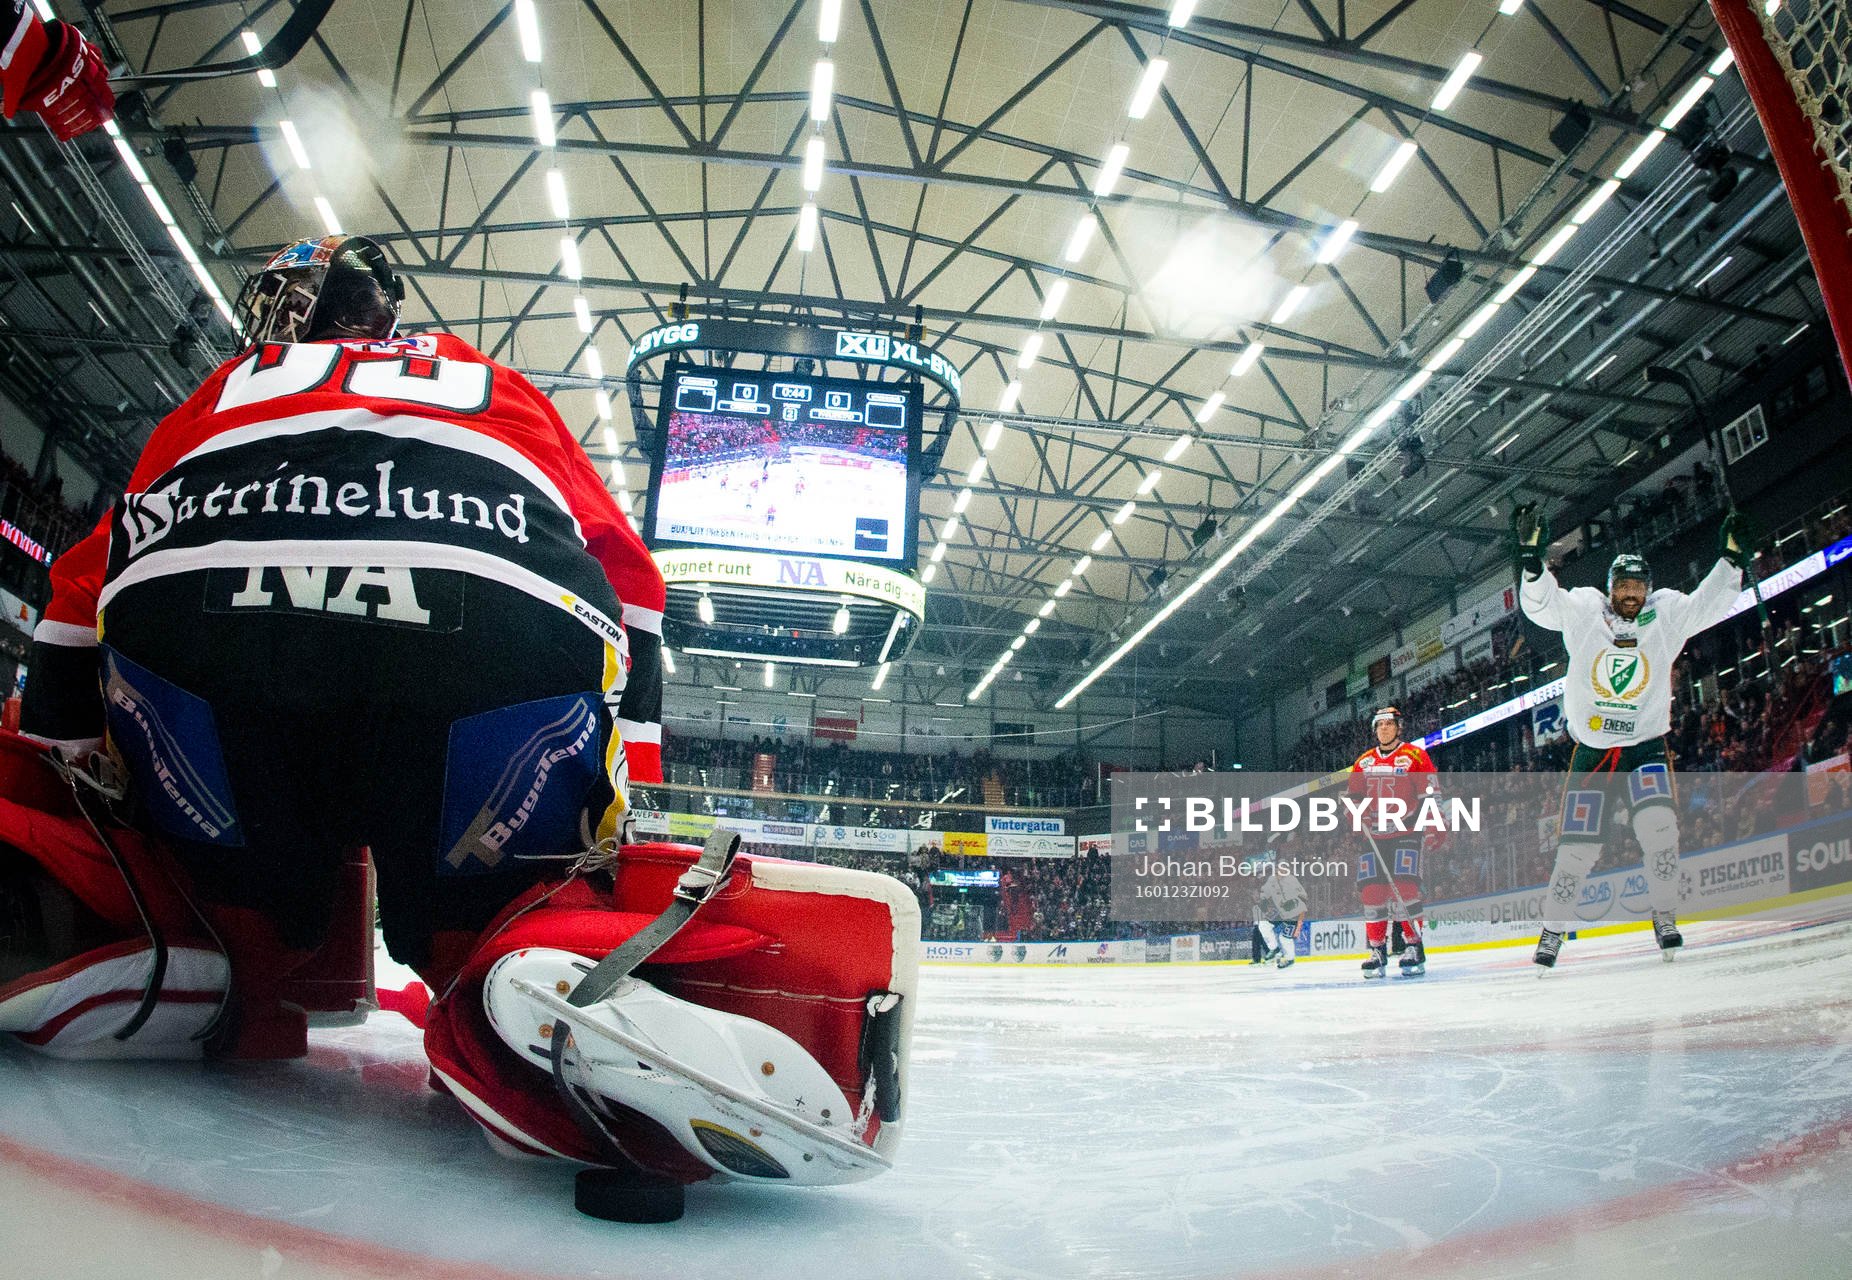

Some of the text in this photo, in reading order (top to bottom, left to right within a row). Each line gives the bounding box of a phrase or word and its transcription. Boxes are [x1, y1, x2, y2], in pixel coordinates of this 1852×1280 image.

[628, 323, 699, 368] L-BYGG
[892, 341, 960, 399] XL-BYG
[742, 387, 751, 398] 0
[832, 395, 841, 407] 0
[663, 560, 752, 576] dygnet runt
[776, 559, 827, 587] NA
[845, 571, 903, 598] Nära dig
[574, 603, 622, 643] EASTON
[1603, 718, 1635, 733] ENERGI
[479, 712, 597, 851] ByggTema
[854, 828, 878, 840] Let's
[991, 818, 1060, 833] Vintergatan
[1700, 851, 1785, 887] PISCATOR
[1701, 872, 1785, 897] ventilation ab
[927, 946, 973, 956] HOIST
